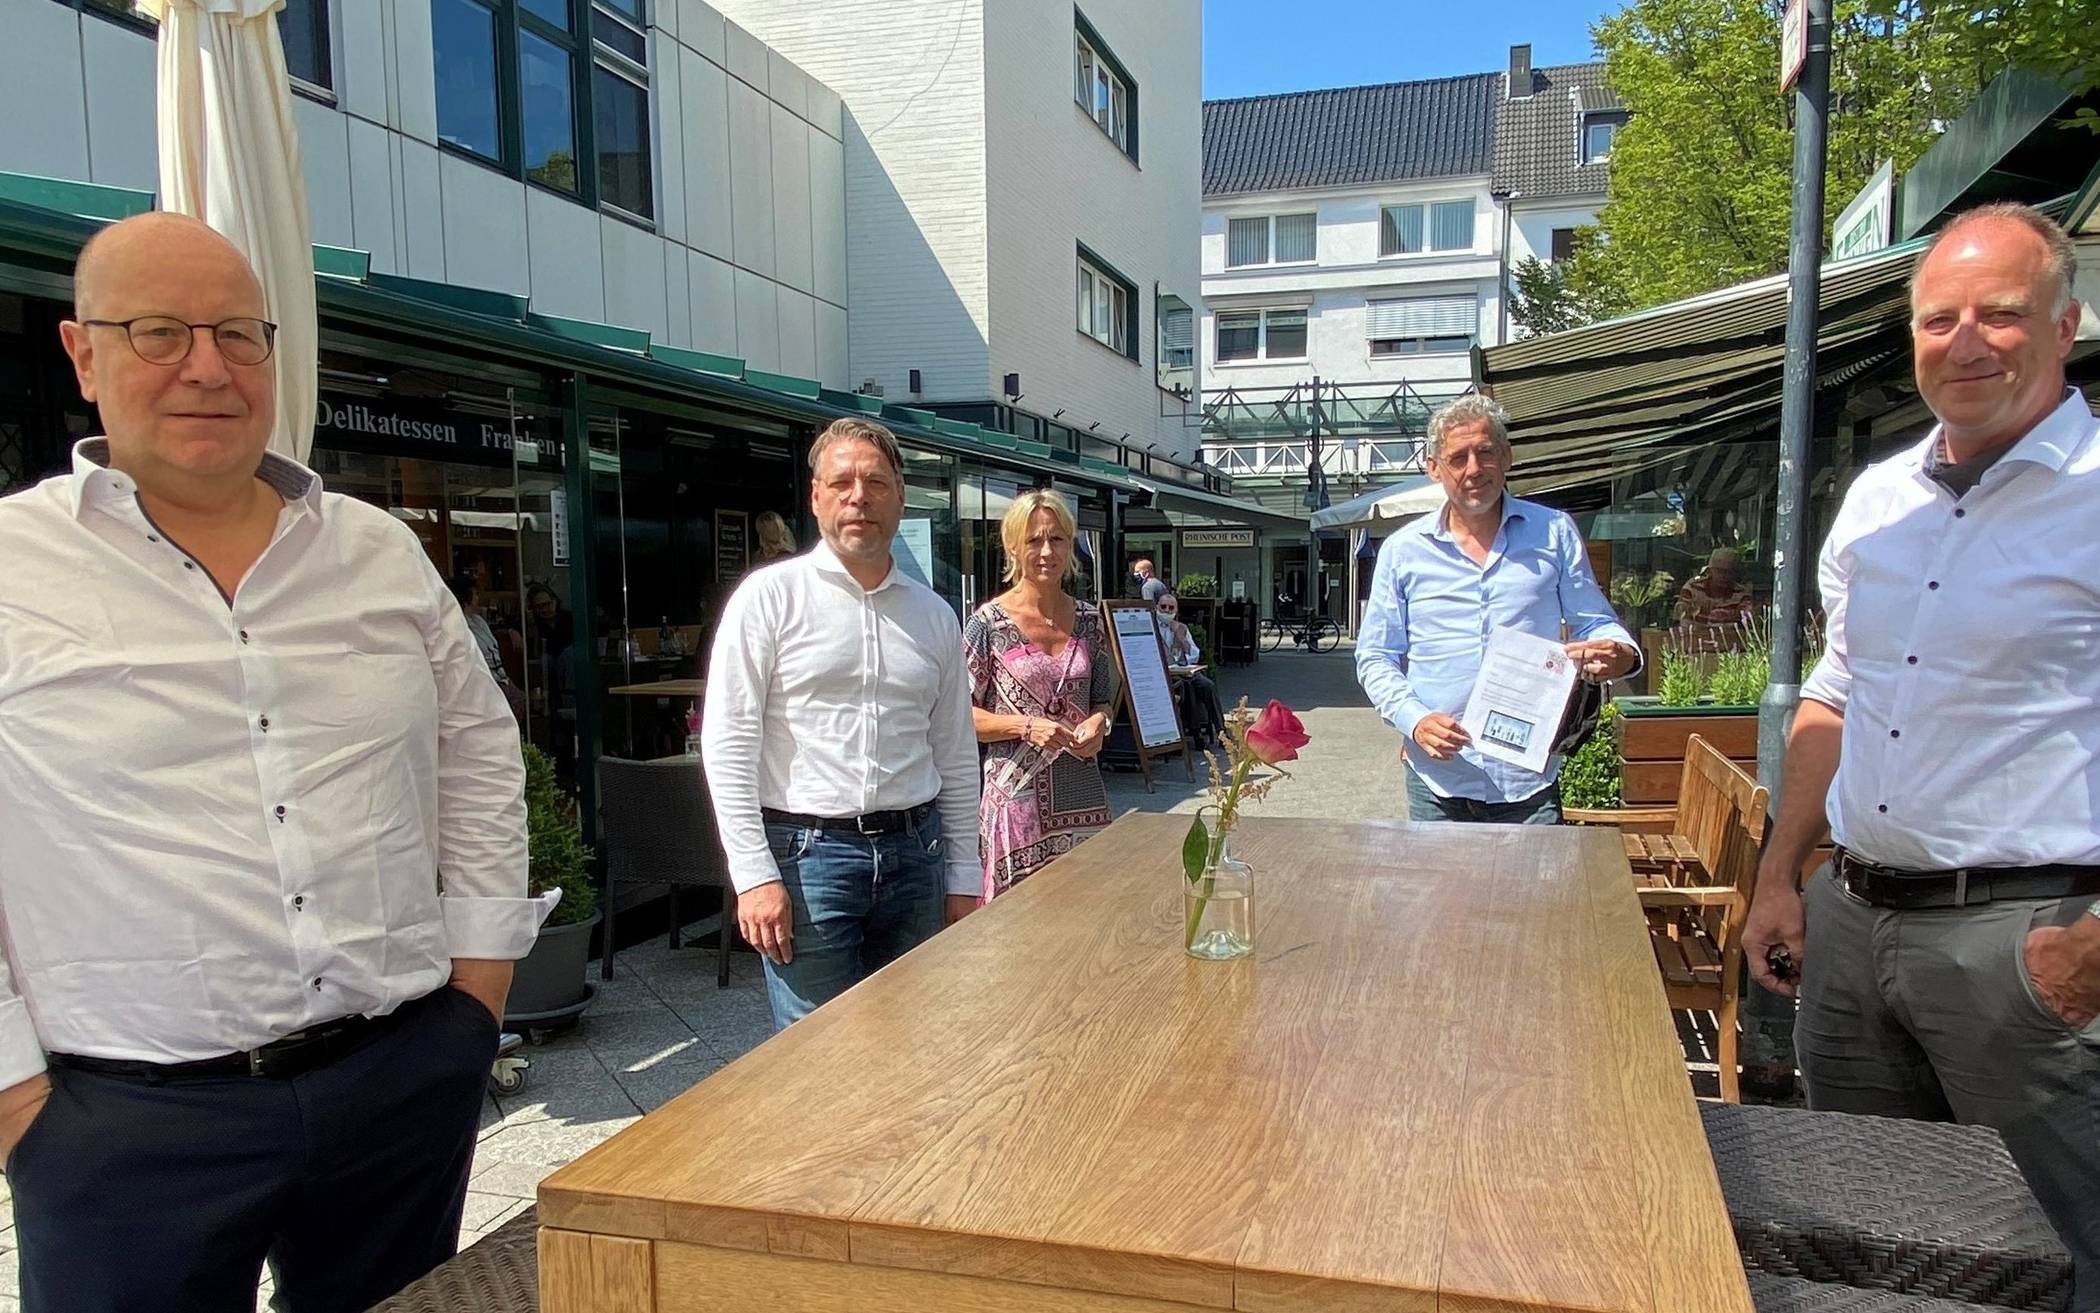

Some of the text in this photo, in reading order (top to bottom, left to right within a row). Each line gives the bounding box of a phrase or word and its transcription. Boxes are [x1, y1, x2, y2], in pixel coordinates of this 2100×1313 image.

[315, 400, 457, 443] Delikatessen
[1185, 532, 1251, 541] RHEINISCHE POST
